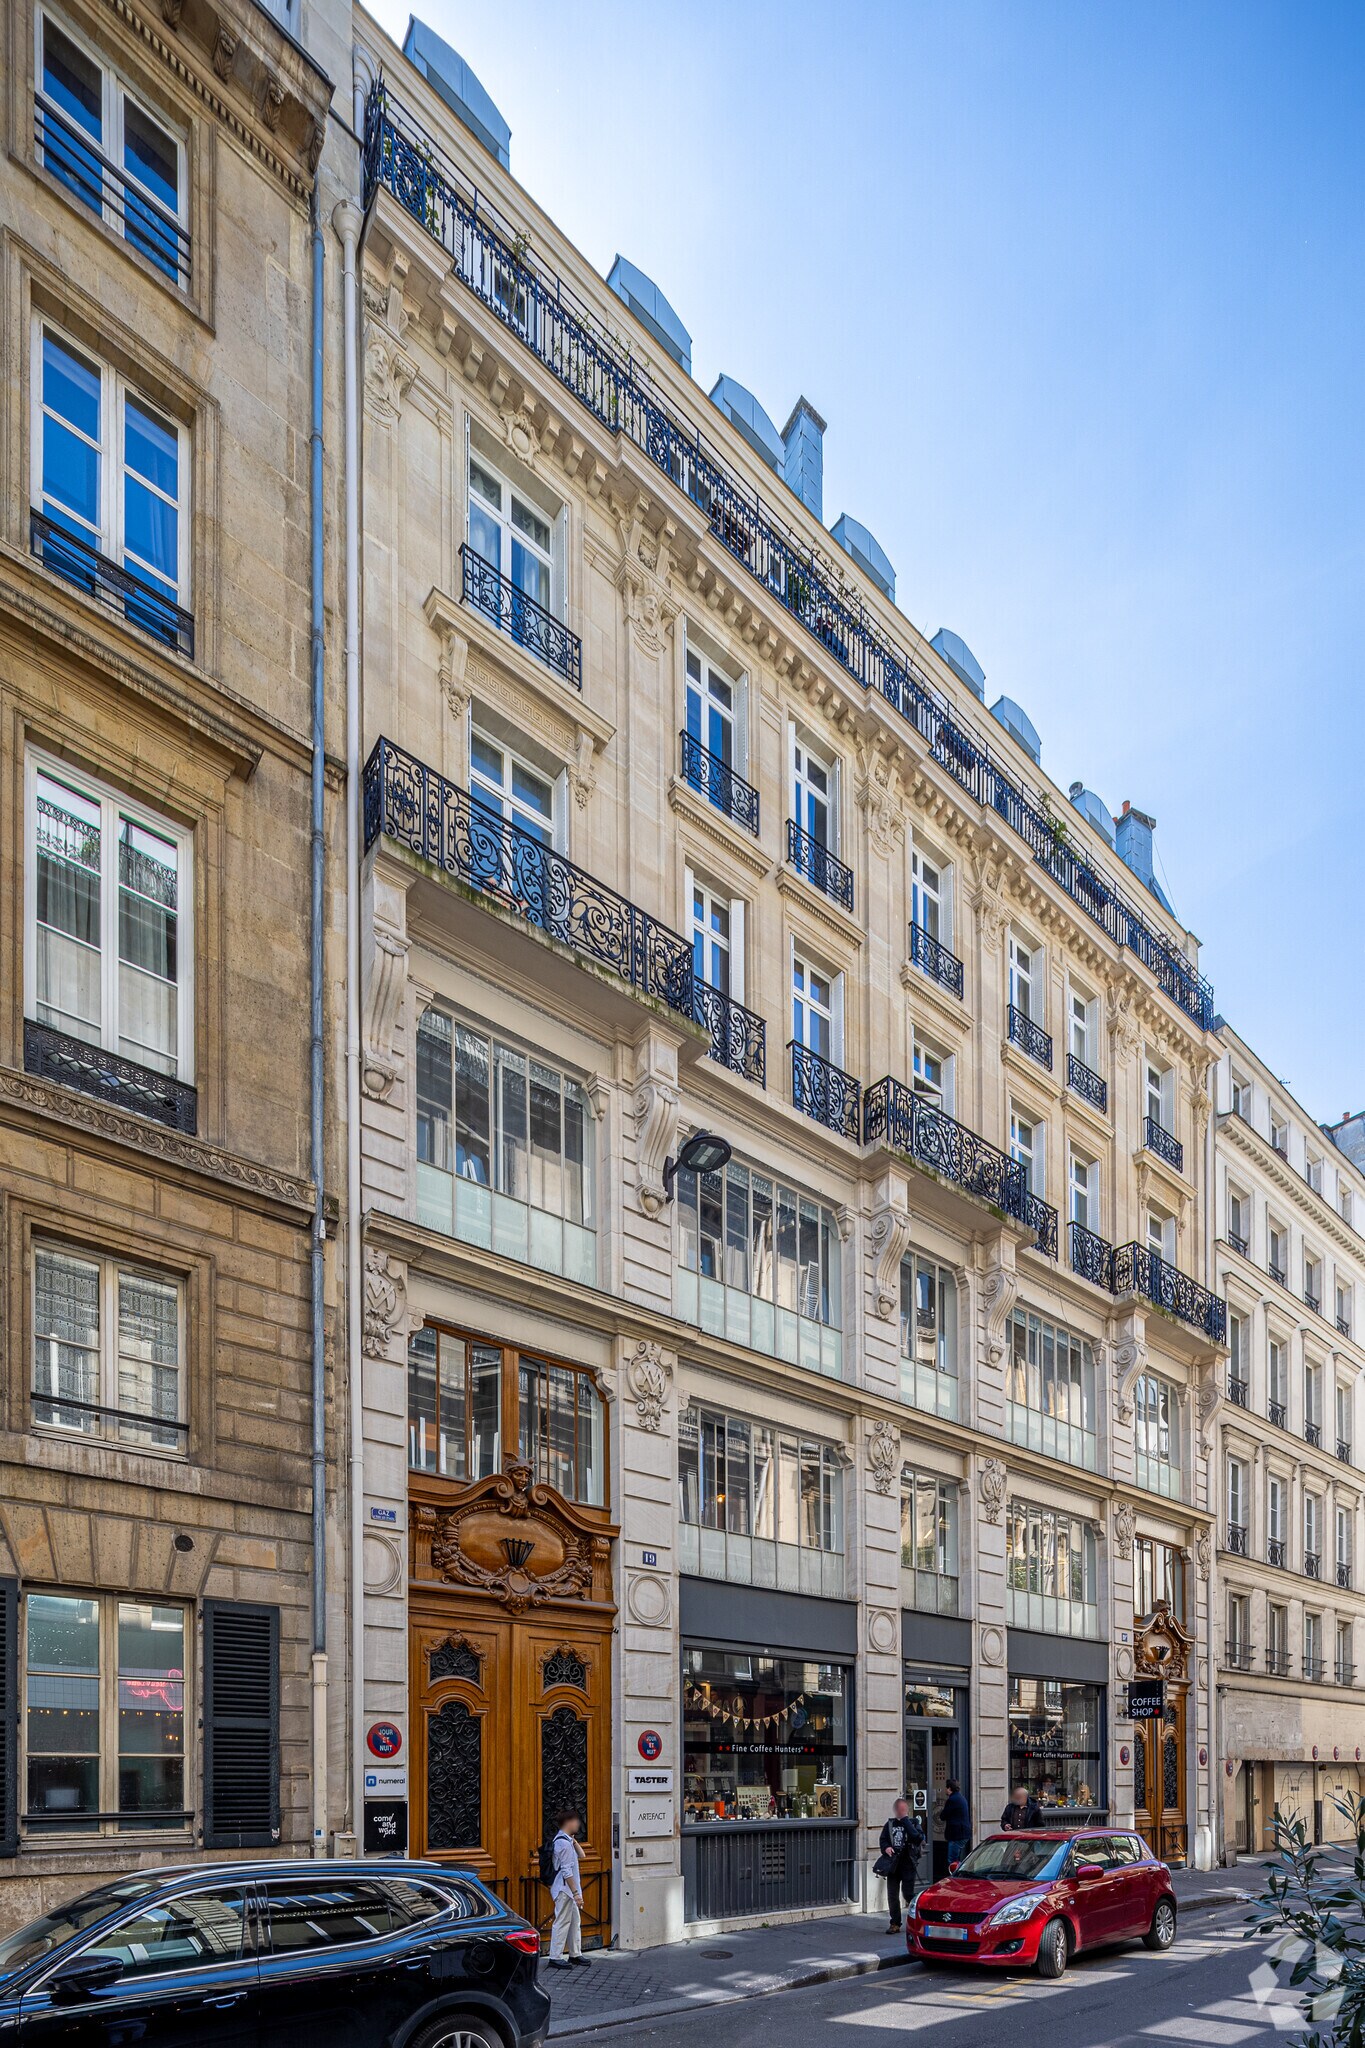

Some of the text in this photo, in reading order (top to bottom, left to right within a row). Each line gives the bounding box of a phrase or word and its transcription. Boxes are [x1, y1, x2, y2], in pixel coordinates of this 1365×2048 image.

[645, 1553, 655, 1563] 19
[1131, 1697, 1161, 1706] COFFEE
[1131, 1708, 1153, 1716] SHOP
[732, 1744, 748, 1752] Fine
[750, 1744, 772, 1753] Coffee
[638, 1812, 666, 1820] ARTEFACT
